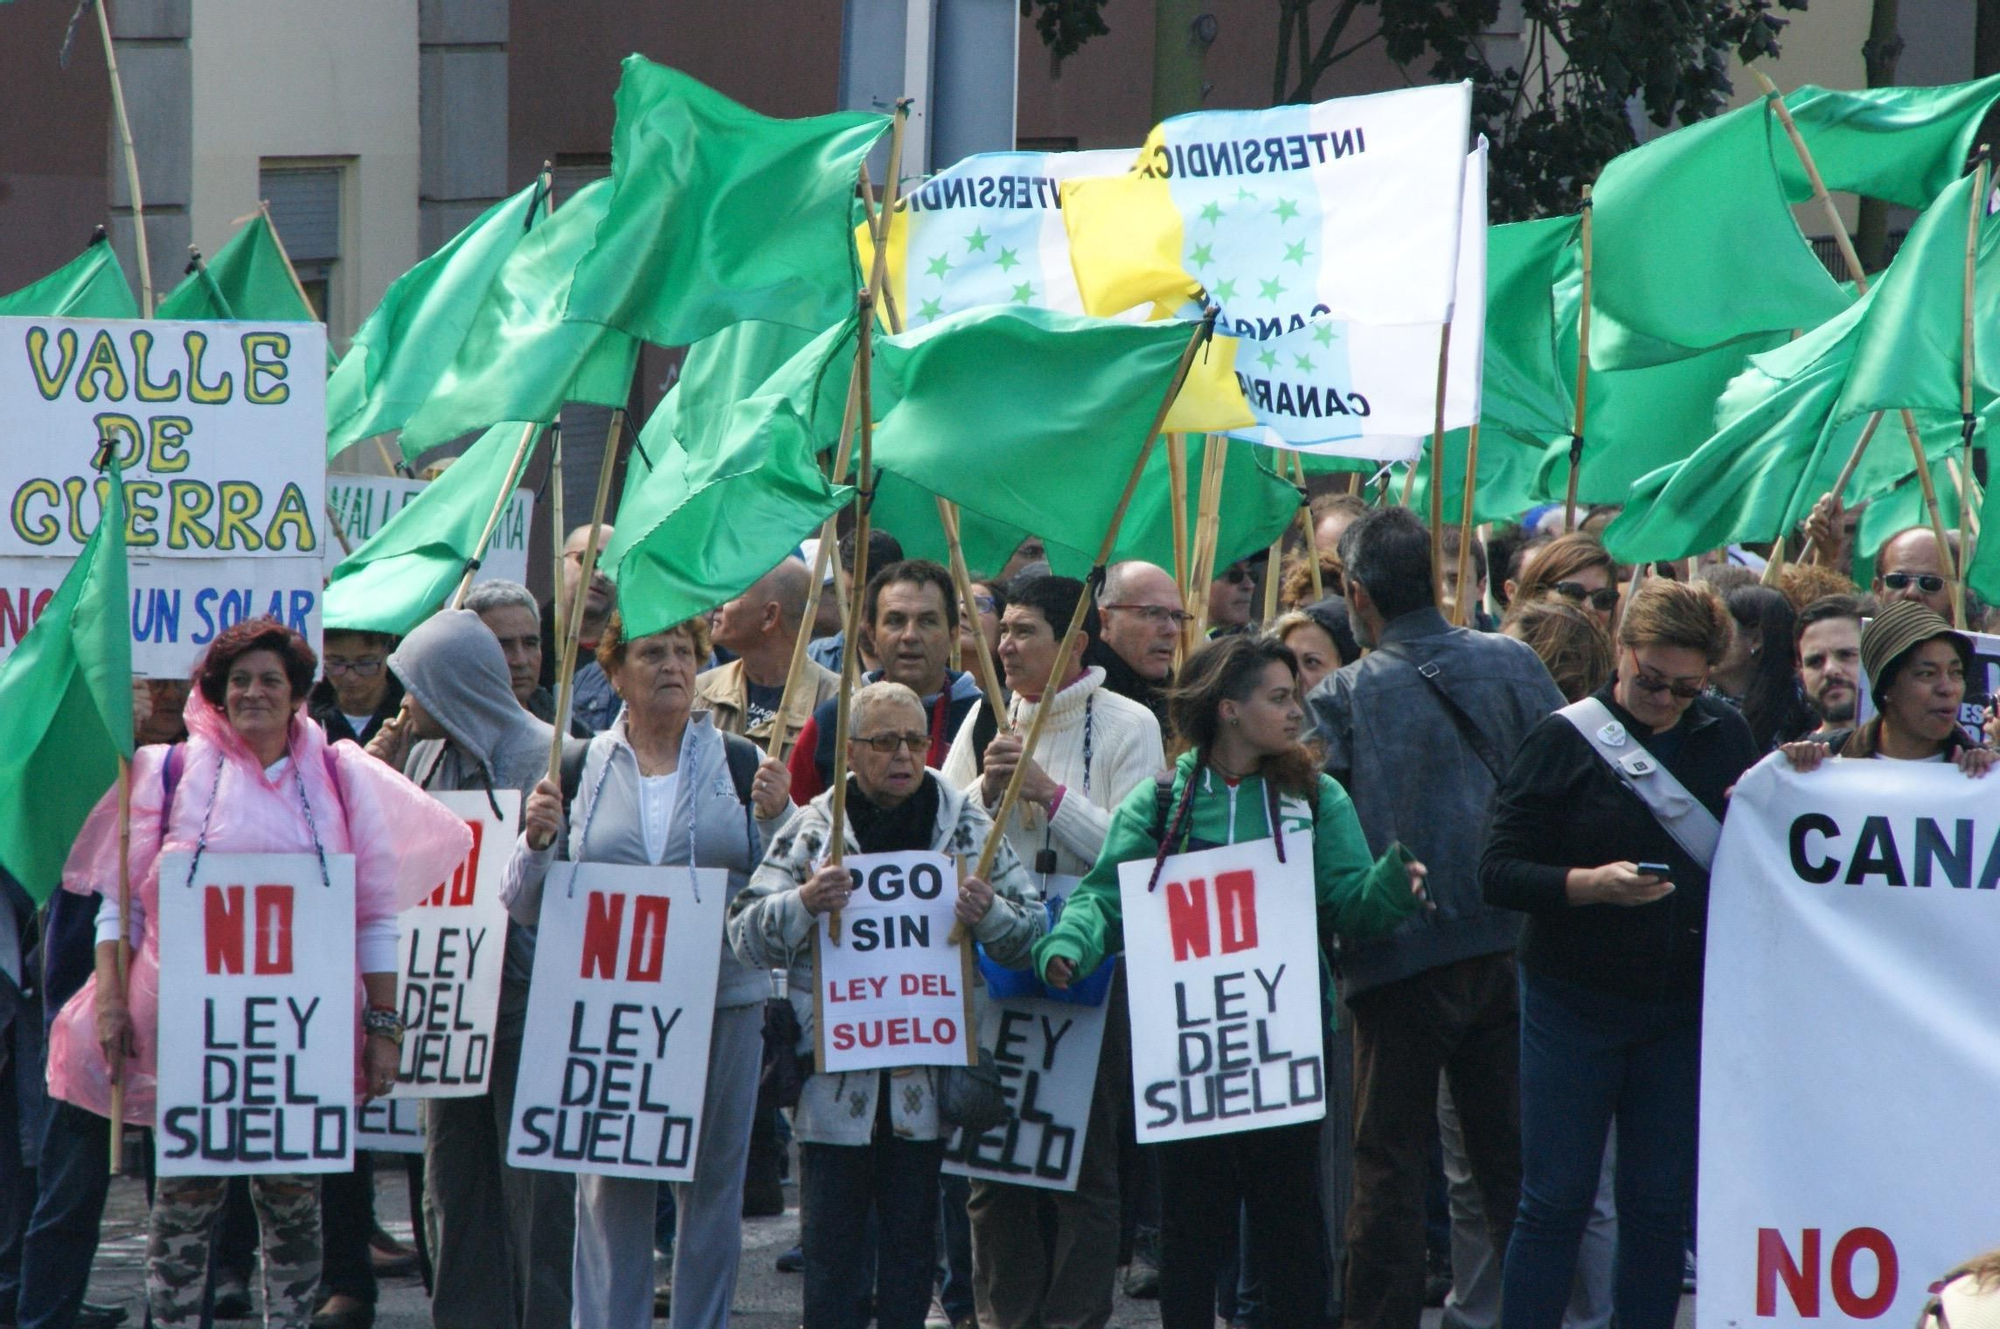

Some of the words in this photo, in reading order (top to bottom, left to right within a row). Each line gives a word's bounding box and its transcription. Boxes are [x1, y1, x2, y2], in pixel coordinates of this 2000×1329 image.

[25, 326, 291, 405] VALLE
[90, 412, 193, 473] DE
[11, 476, 316, 551] GUERRA
[132, 588, 180, 644] UN
[204, 885, 295, 975] NO
[580, 891, 671, 982] NO
[851, 915, 930, 952] SIN
[1166, 870, 1259, 963] NO
[407, 927, 487, 980] LEY
[402, 982, 474, 1031] DEL
[829, 975, 889, 1004] LEY
[900, 974, 956, 997] DEL
[1175, 964, 1286, 1029] LEY
[203, 997, 320, 1051] LEY
[569, 1000, 682, 1060] LEY
[832, 1017, 957, 1051] SUELO
[995, 1009, 1074, 1072] EY
[1178, 1019, 1292, 1077] DEL
[203, 1055, 319, 1105] DEL
[397, 1034, 489, 1085] UELO
[562, 1057, 670, 1113] DEL
[1145, 1056, 1323, 1130] SUELO
[164, 1106, 347, 1161] SUELO
[516, 1106, 693, 1169] SUELO
[1756, 1227, 1899, 1319] NO
